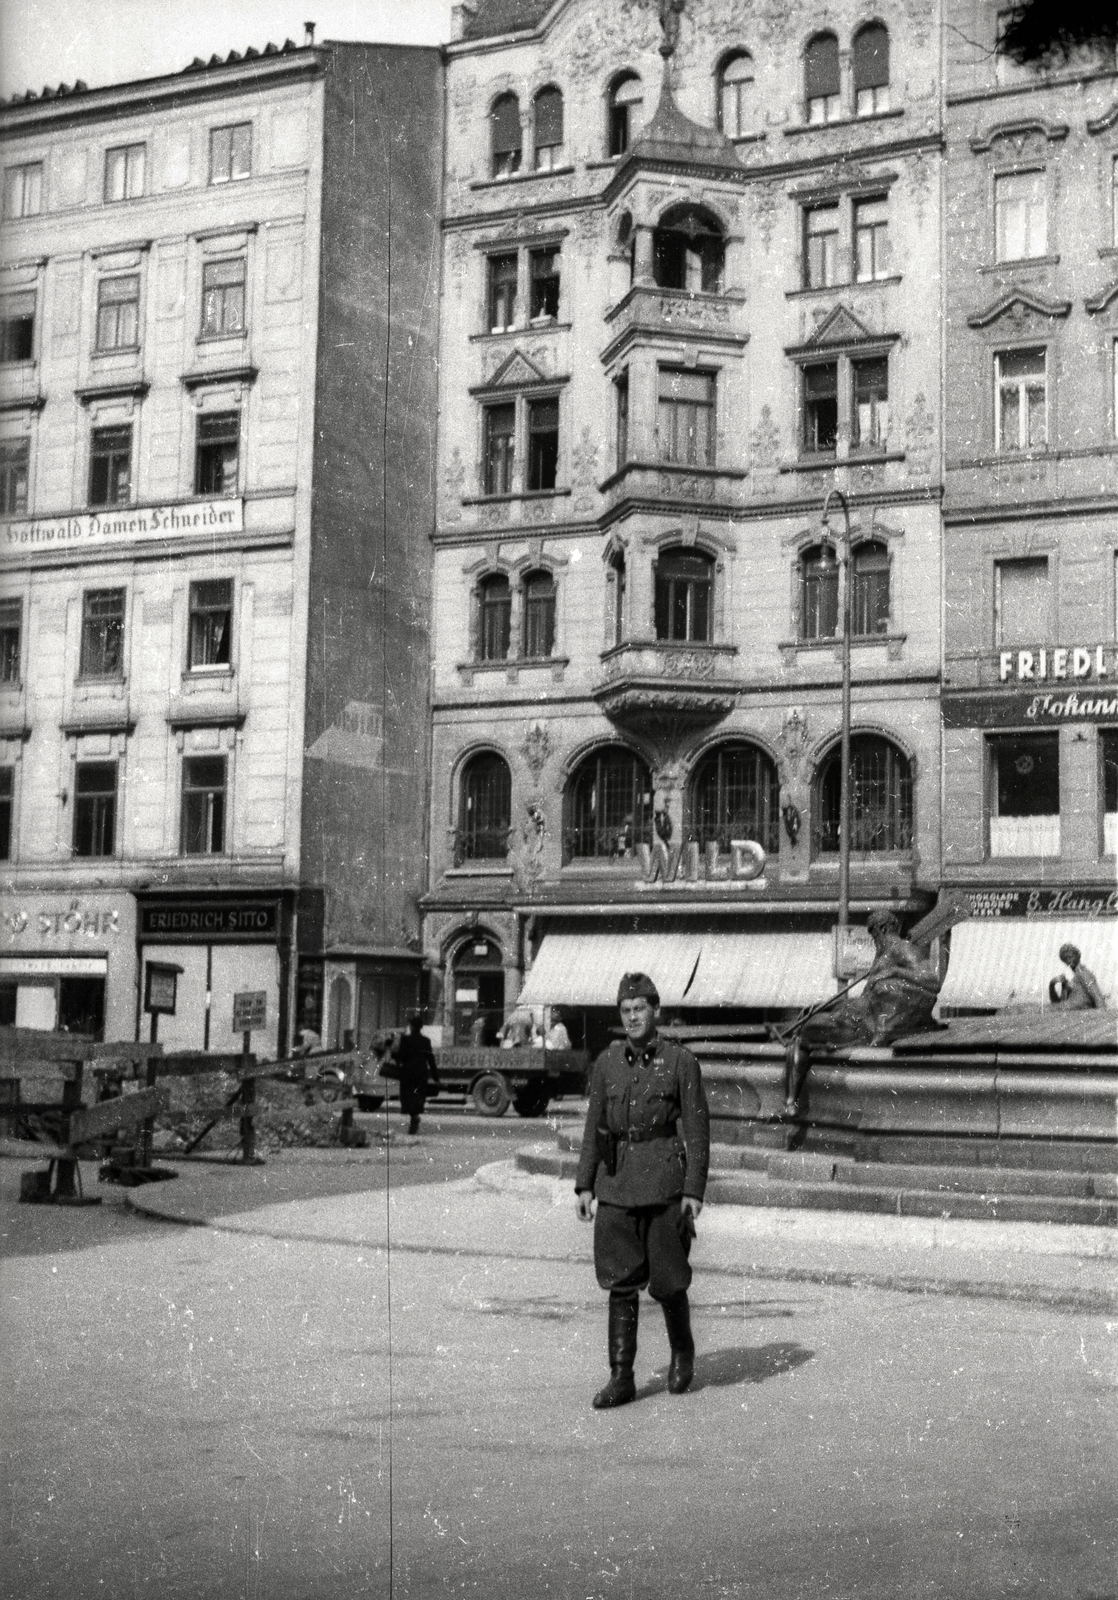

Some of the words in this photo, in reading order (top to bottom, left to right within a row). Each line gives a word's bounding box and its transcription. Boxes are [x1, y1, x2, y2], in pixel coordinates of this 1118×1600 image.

[88, 514, 147, 536] Damen
[149, 504, 236, 530] Schneider
[1000, 645, 1107, 680] FRIEDL
[636, 839, 766, 883] WILD
[965, 892, 1020, 902] HOKOLADE
[970, 900, 1013, 910] ONBONS,
[149, 911, 223, 928] FRIEDRICH
[227, 910, 268, 928] SITTO
